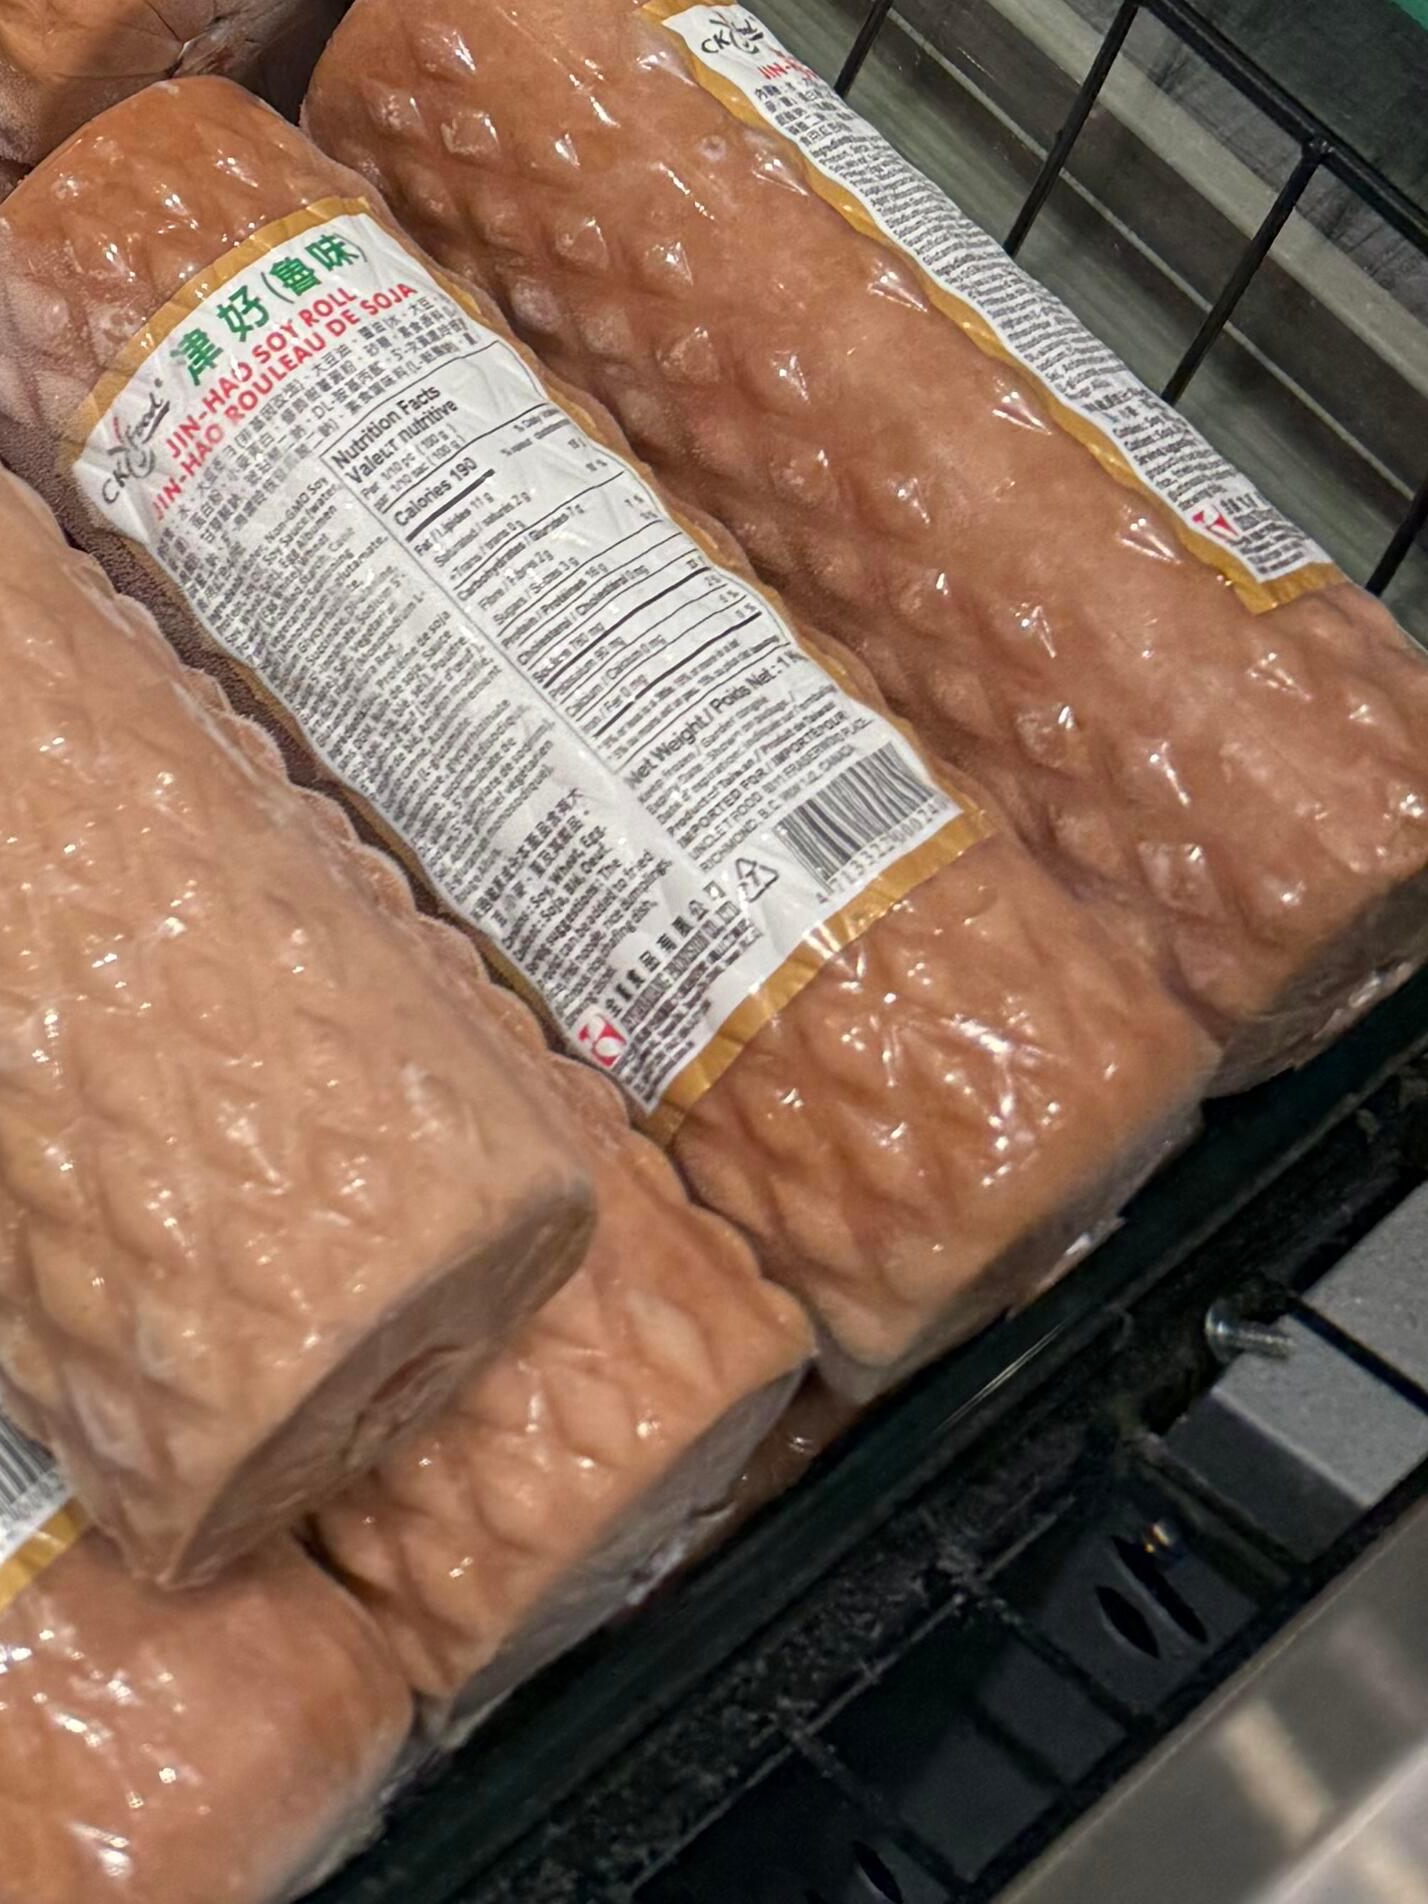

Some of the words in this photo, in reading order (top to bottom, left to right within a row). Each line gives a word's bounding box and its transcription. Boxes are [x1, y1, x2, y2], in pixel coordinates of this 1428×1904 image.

[164, 358, 255, 460] JIN-HAO
[250, 317, 302, 365] SOY
[299, 281, 358, 329] ROLL
[165, 221, 369, 389] 津好(魯味)
[96, 462, 133, 506] CK
[121, 388, 166, 449] Food
[148, 422, 228, 520] JIN-HAO
[224, 328, 327, 426] ROULEAU
[324, 307, 361, 339] DE
[362, 276, 418, 318] SOJA
[329, 406, 403, 469] Nutrition
[398, 380, 441, 418] Facts
[391, 474, 453, 527] Calories
